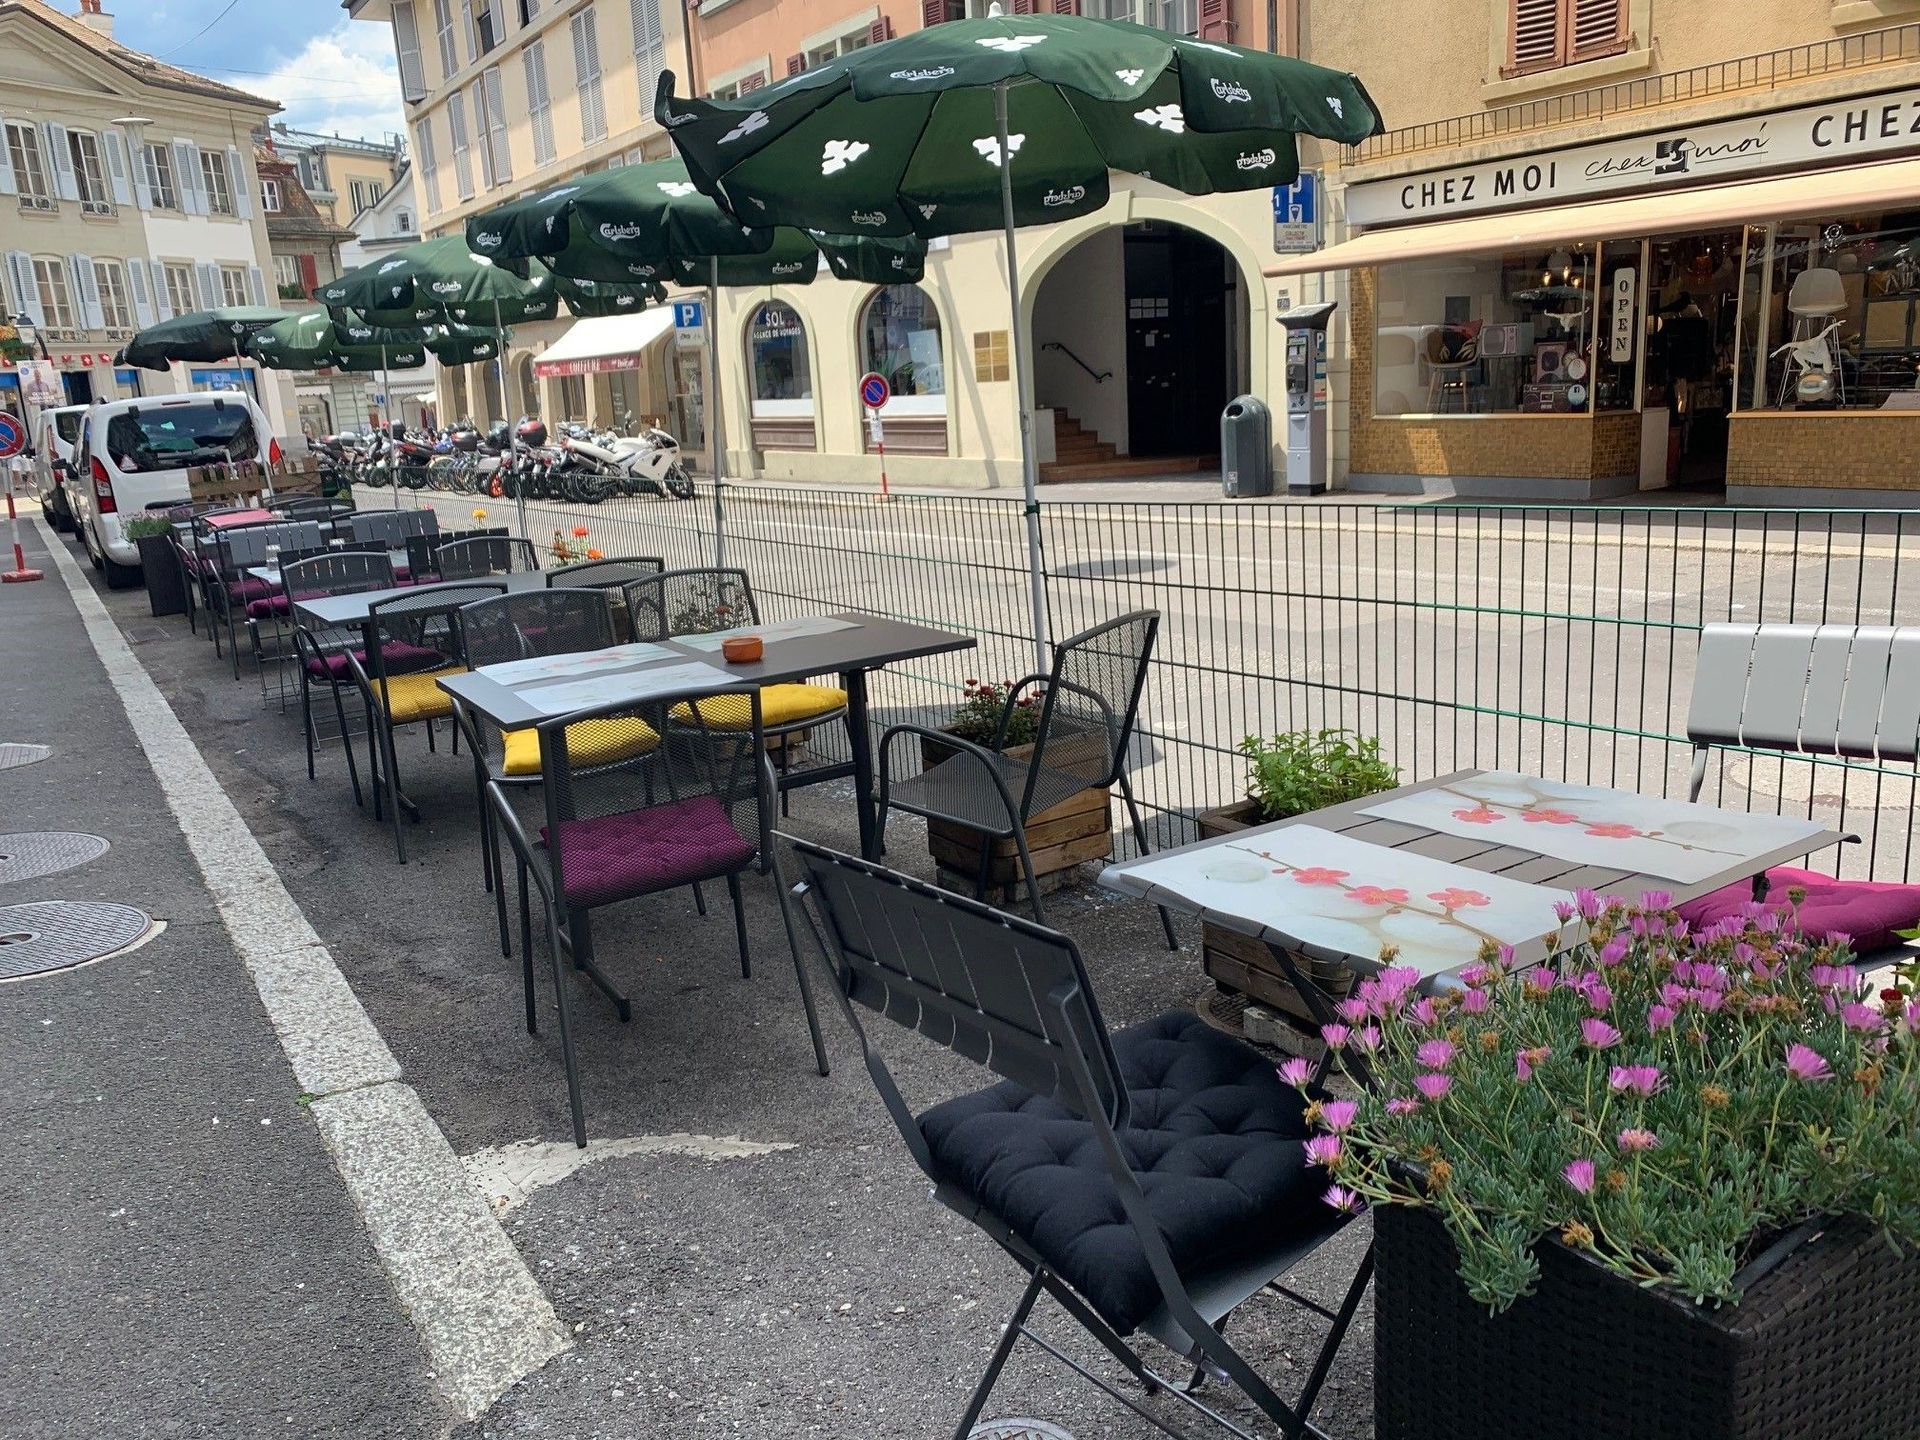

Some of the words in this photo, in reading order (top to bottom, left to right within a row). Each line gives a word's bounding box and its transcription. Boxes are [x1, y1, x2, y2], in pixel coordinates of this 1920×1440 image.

[890, 66, 955, 81] Carlsberg
[1210, 78, 1252, 103] Carlsberg
[1289, 175, 1302, 204] P
[1401, 175, 1476, 210] CHEZ
[1494, 161, 1556, 197] MOI
[600, 221, 641, 242] Carlsberg
[681, 305, 695, 327] P
[765, 311, 785, 328] SOL
[1616, 279, 1629, 351] OPEN
[1316, 332, 1325, 349] P
